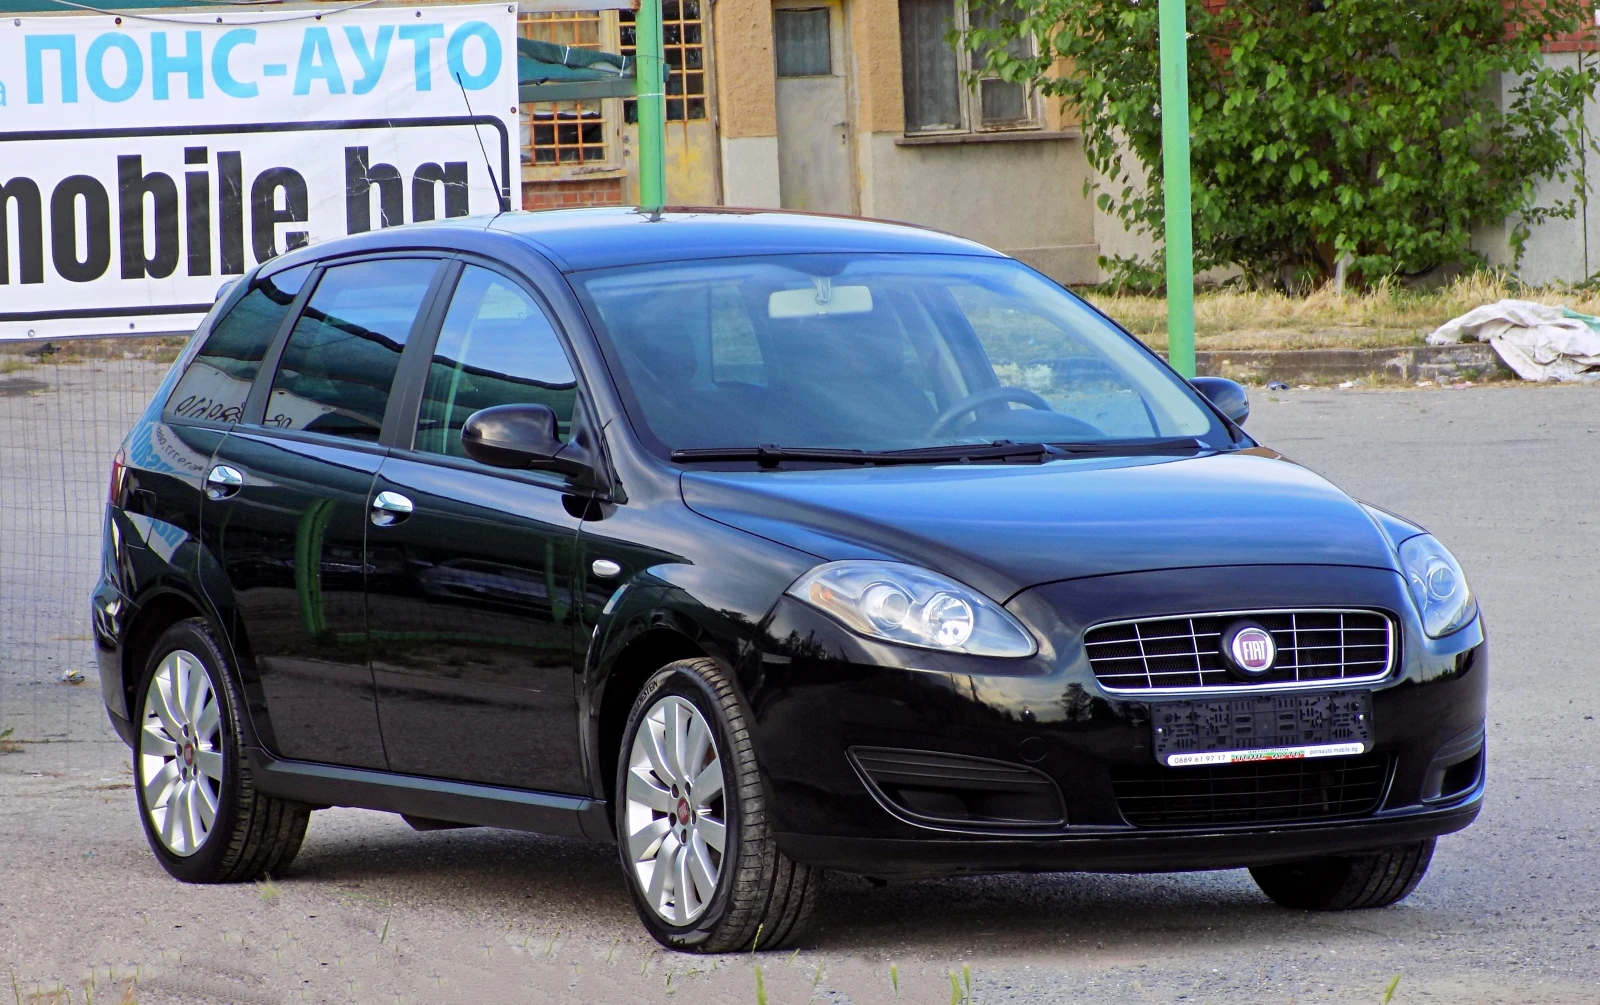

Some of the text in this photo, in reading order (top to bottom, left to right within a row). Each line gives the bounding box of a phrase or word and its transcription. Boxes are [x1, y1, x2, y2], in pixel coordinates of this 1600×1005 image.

[25, 21, 503, 104] ПОНС-АУТО
[1242, 640, 1266, 661] FIAT
[1174, 756, 1193, 764] 0889
